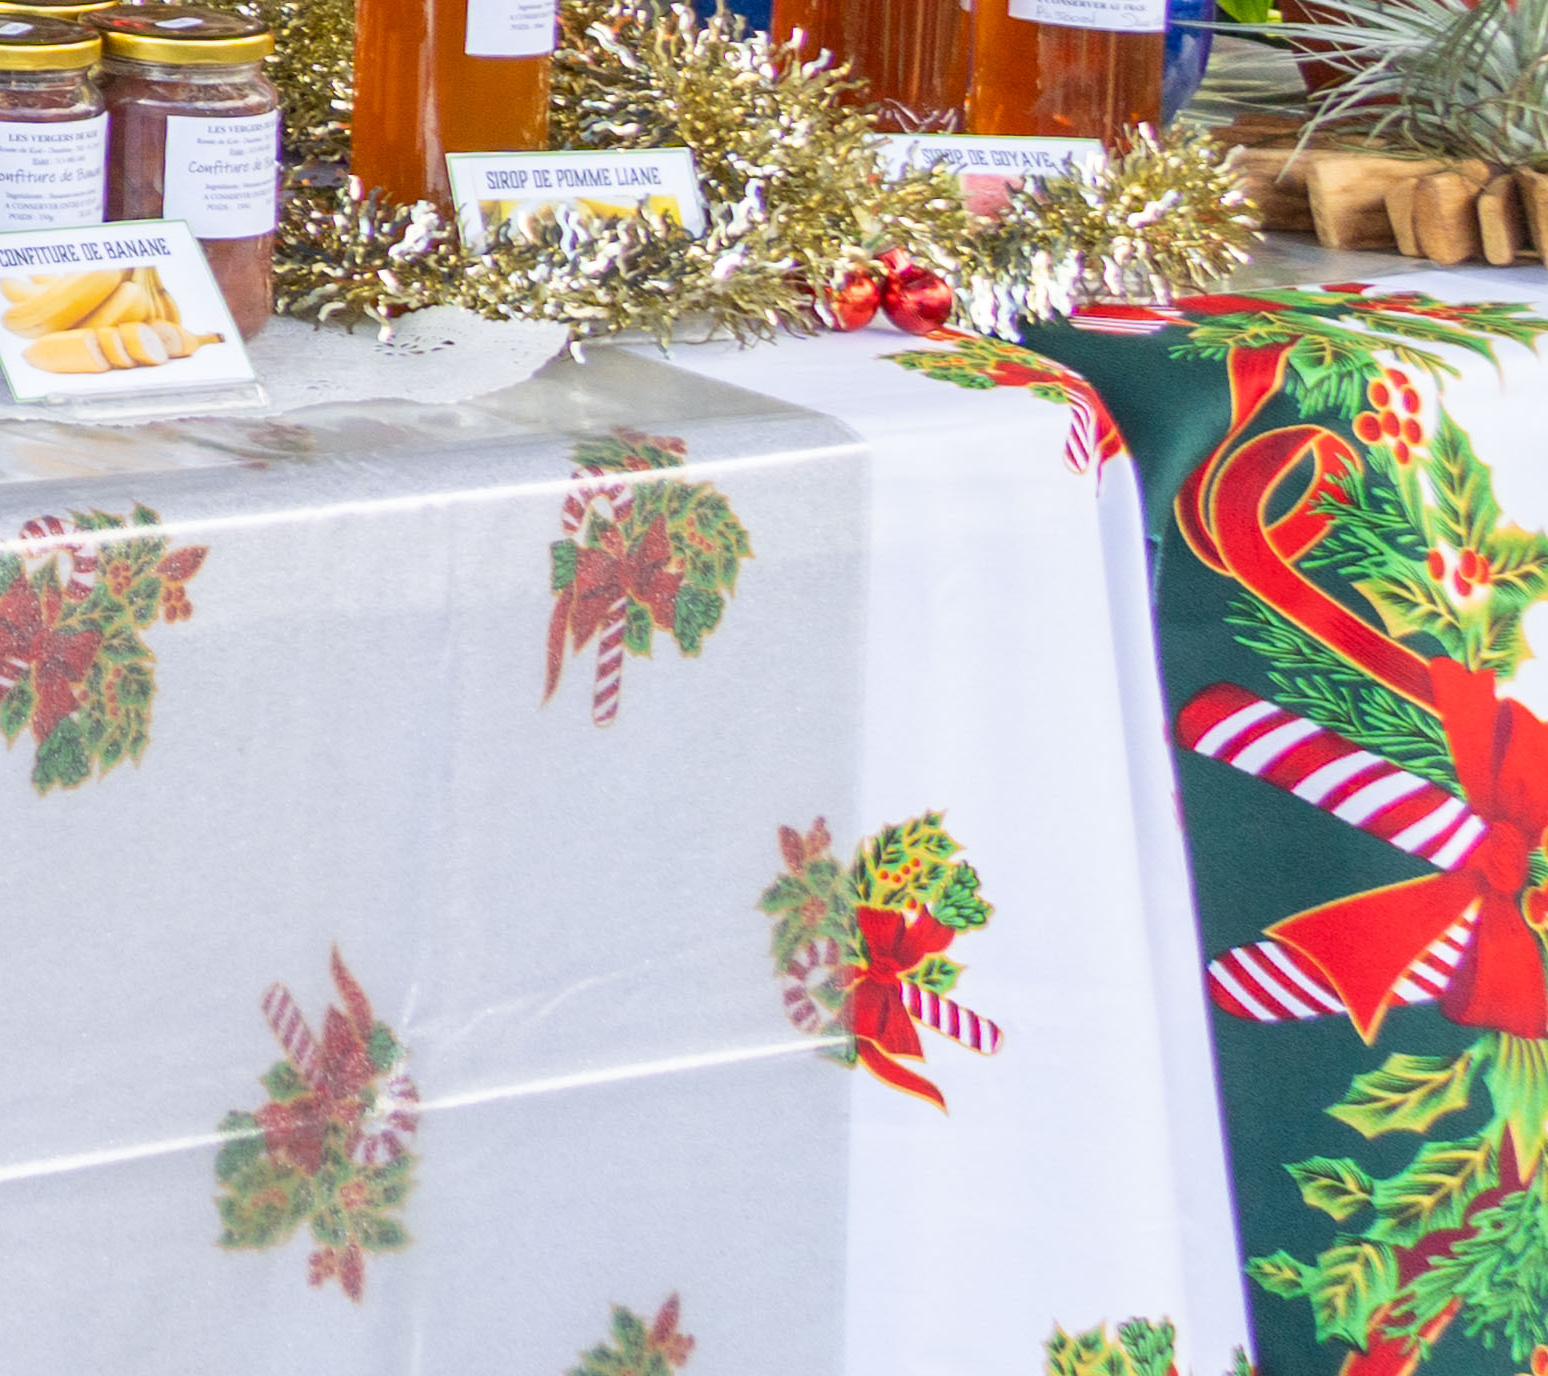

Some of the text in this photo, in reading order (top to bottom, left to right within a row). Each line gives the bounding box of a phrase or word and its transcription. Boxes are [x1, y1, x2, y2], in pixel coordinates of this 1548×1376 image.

[208, 125, 226, 134] LES
[8, 133, 74, 143] LES VERGERS
[967, 147, 986, 167] DE
[986, 147, 1056, 170] GOYAVE
[188, 160, 250, 174] Confiture
[60, 169, 73, 183] de
[485, 164, 662, 189] SIROP DE POMME LIANE
[84, 243, 103, 261] DE
[106, 237, 172, 259] BANANE
